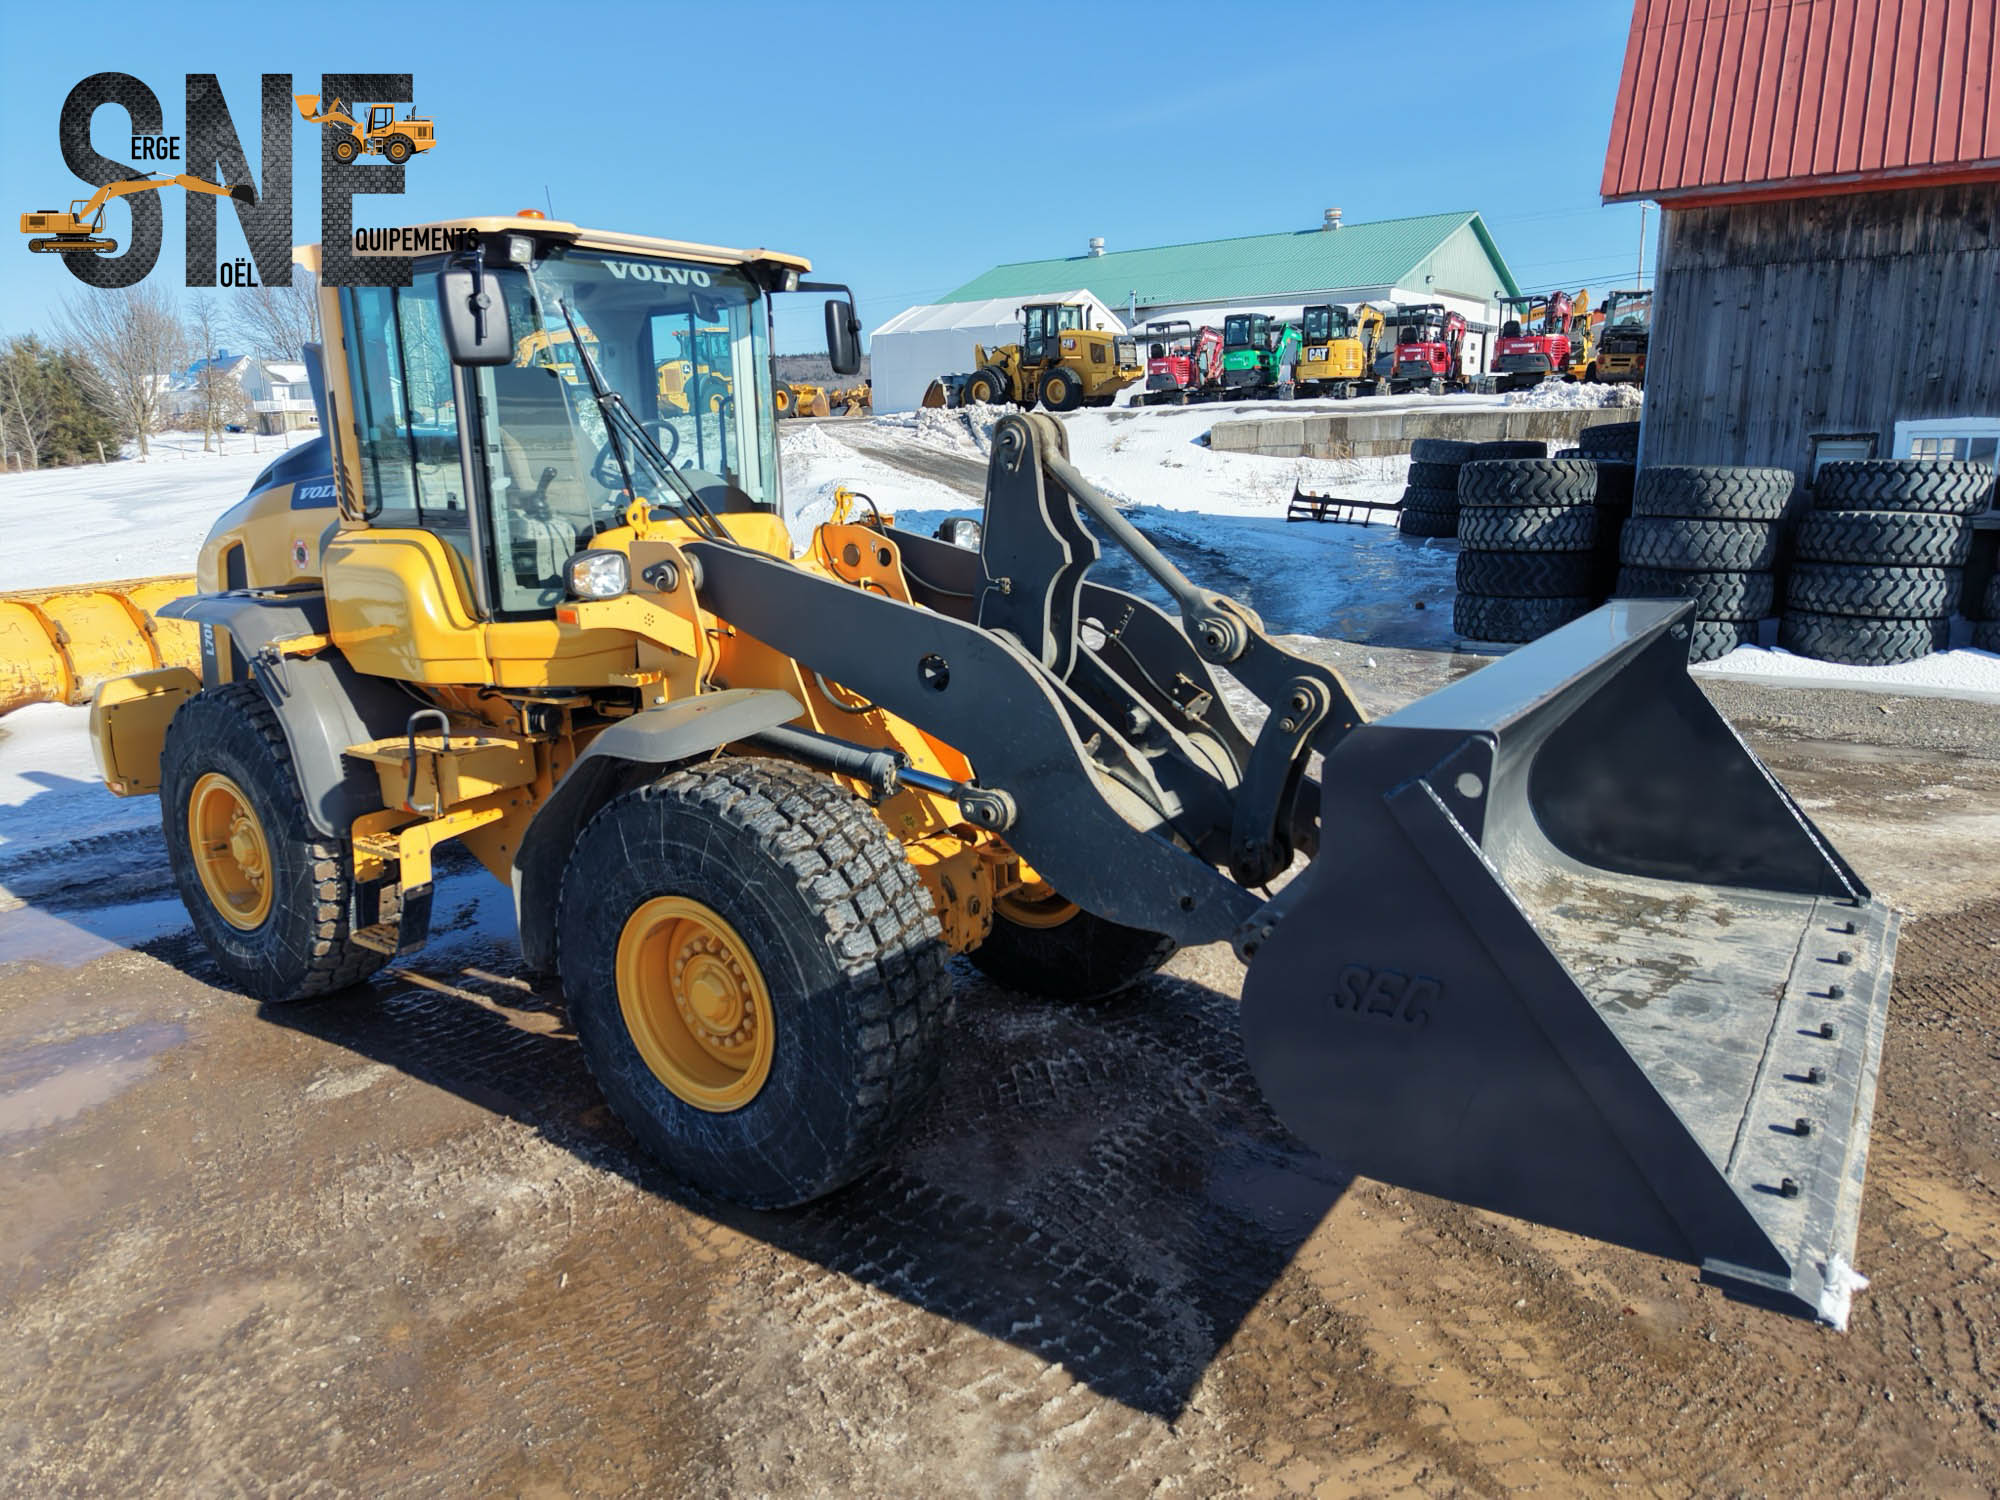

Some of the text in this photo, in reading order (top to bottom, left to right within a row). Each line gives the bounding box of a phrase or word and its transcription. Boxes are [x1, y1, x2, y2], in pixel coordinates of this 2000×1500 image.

[600, 260, 711, 288] VOLVO
[1309, 348, 1328, 361] CAT
[1328, 962, 1442, 1025] SEC
